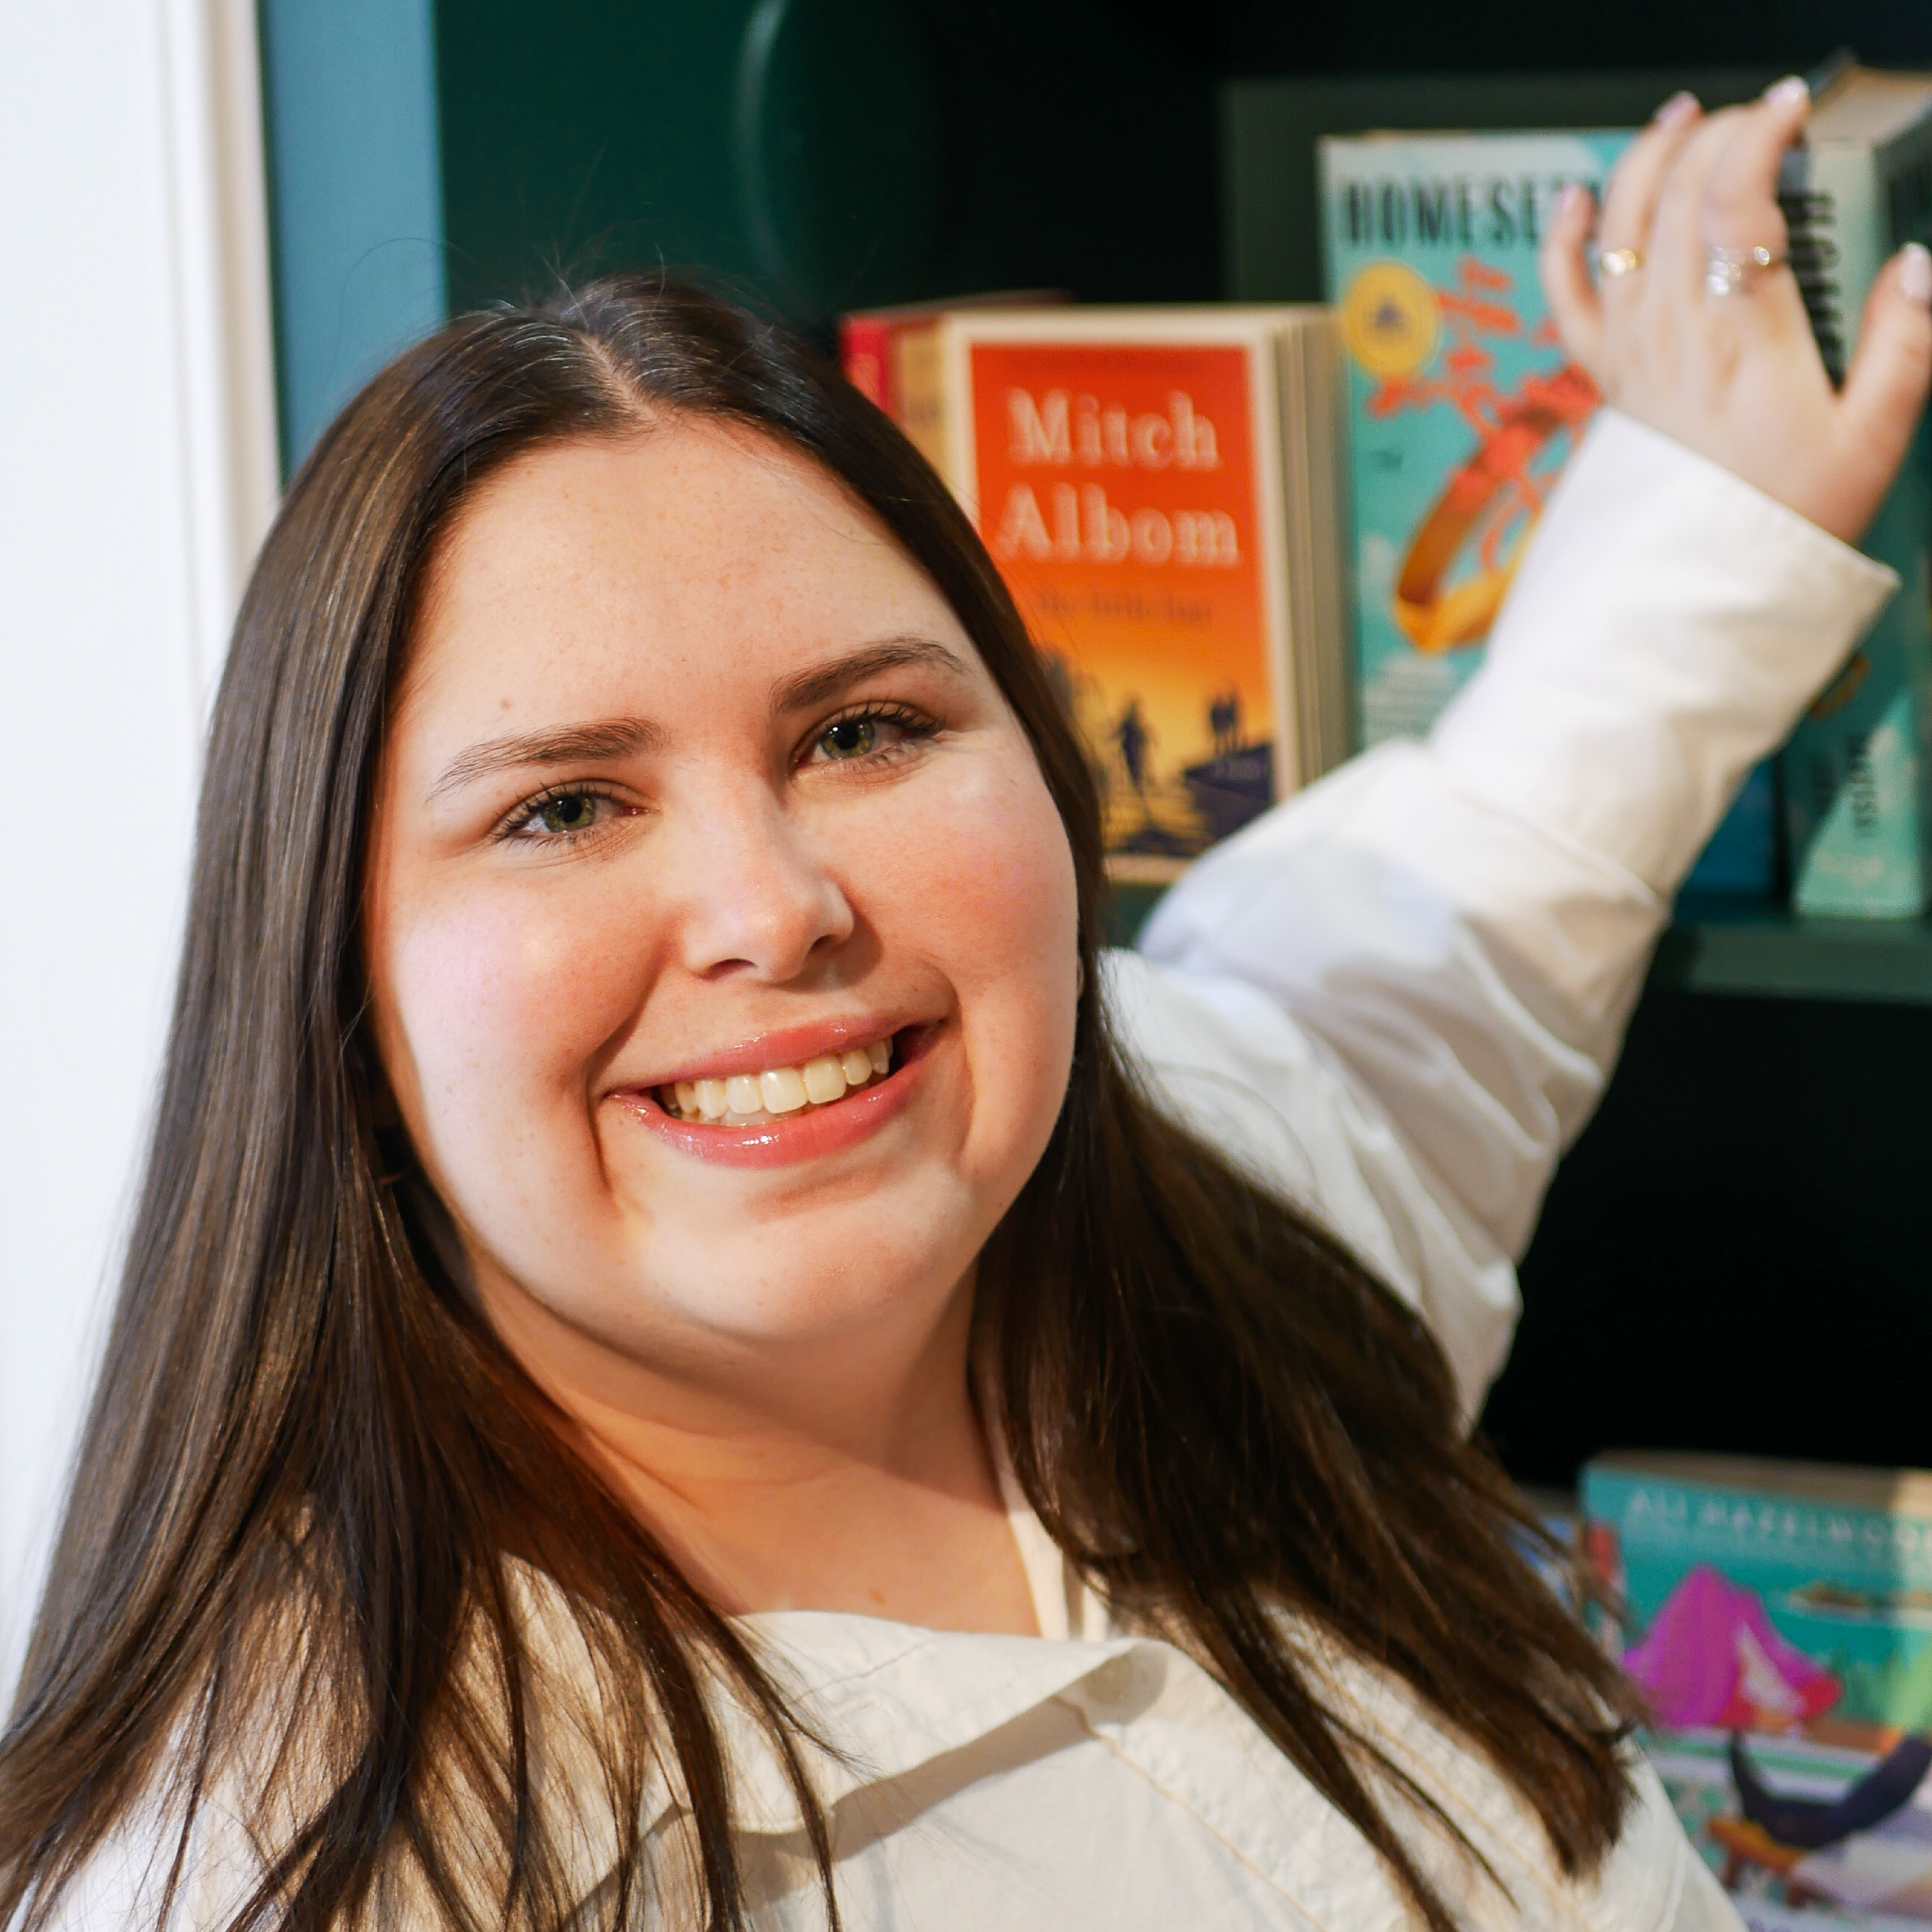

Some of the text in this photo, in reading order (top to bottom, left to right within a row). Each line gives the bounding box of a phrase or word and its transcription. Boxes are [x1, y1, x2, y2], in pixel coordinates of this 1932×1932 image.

[1345, 175, 1601, 246] HOMESE
[1006, 386, 1223, 471] Mitch
[994, 482, 1241, 568] Albom
